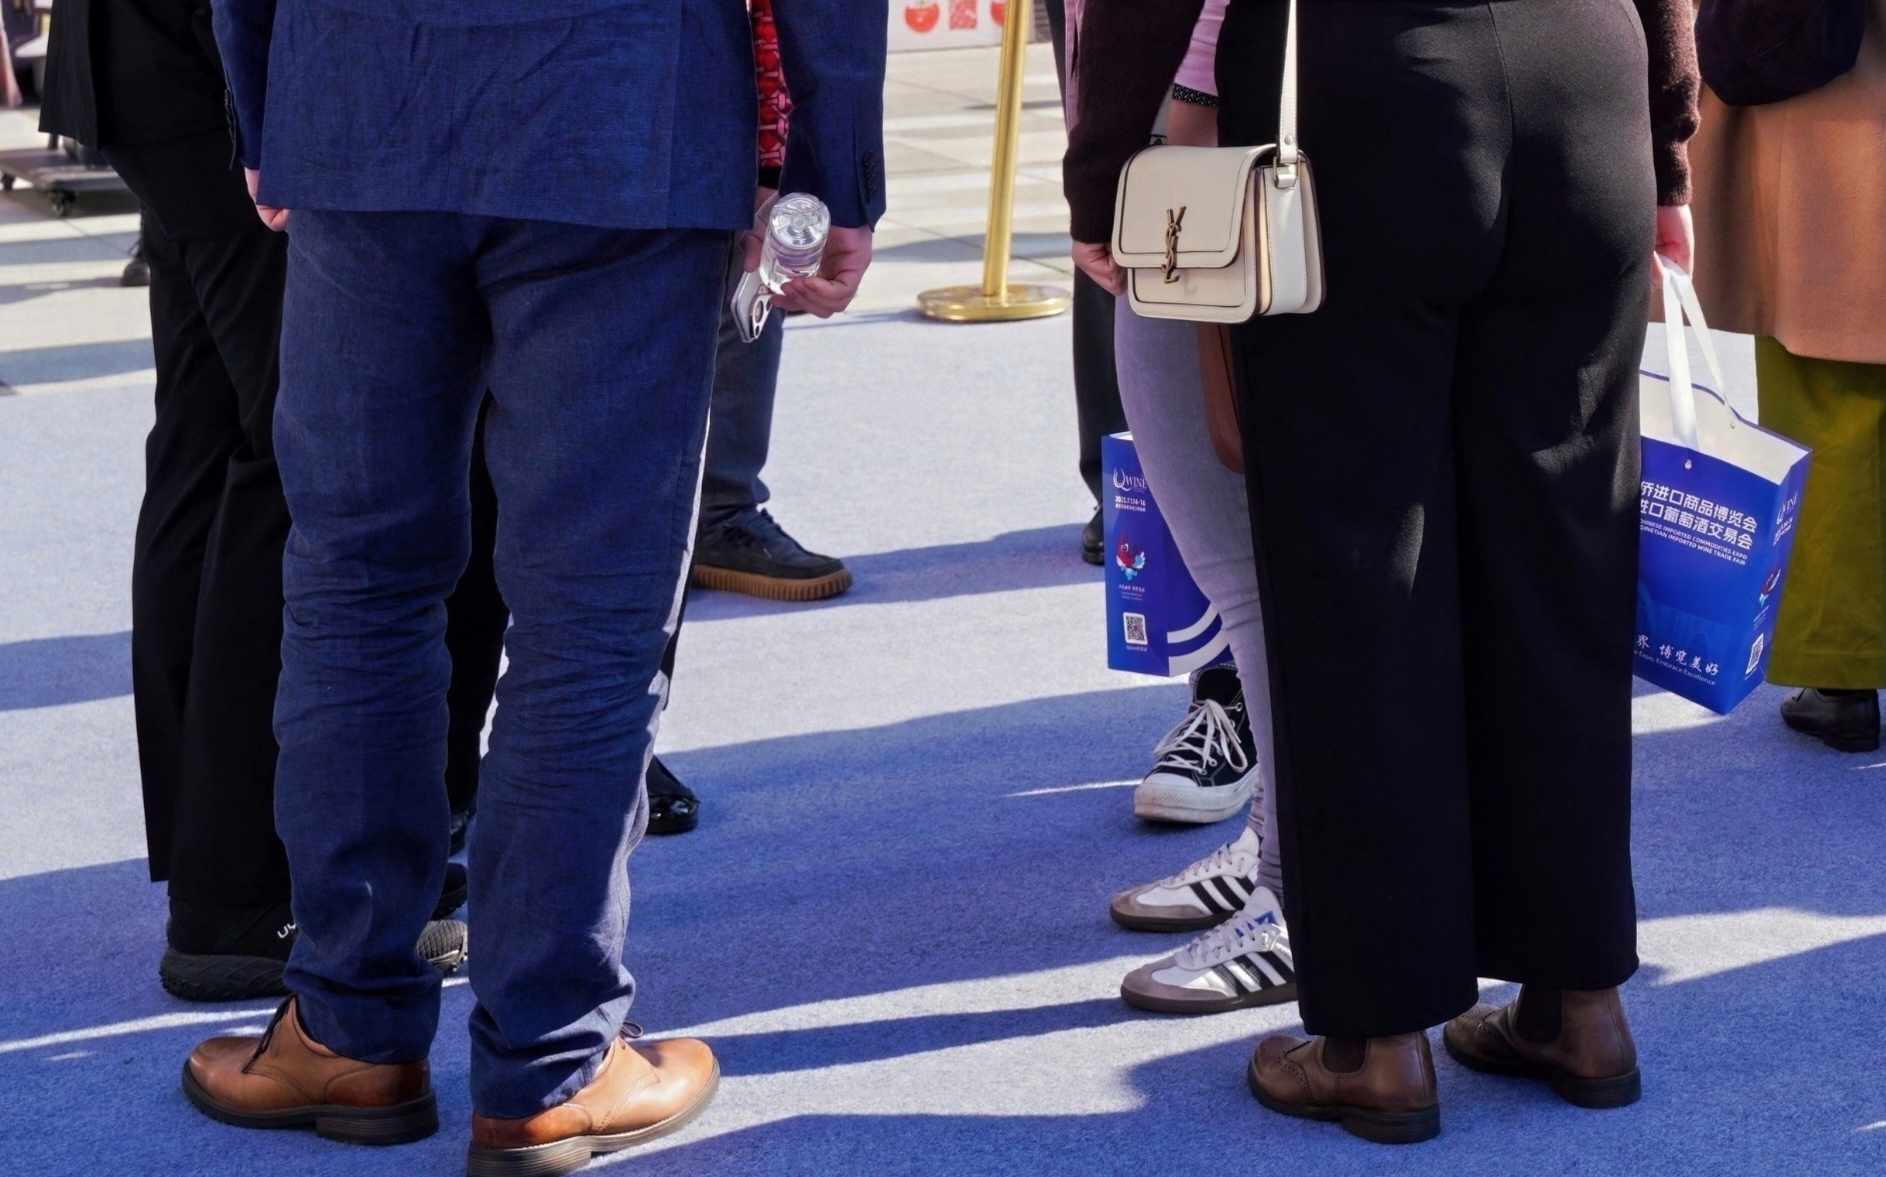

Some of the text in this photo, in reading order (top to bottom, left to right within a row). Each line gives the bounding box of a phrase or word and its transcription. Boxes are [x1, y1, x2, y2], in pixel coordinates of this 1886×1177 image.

[1663, 524, 1691, 540] IMPORTED
[1692, 536, 1731, 554] COMMODITIES
[1732, 549, 1748, 560] EXPO
[1668, 533, 1697, 548] IMPORTED
[1697, 543, 1713, 555] WINE
[1713, 548, 1732, 561] TRADE
[1732, 555, 1746, 566] FAIR
[1656, 657, 1683, 673] Embrace
[1683, 669, 1717, 686] Excellence
